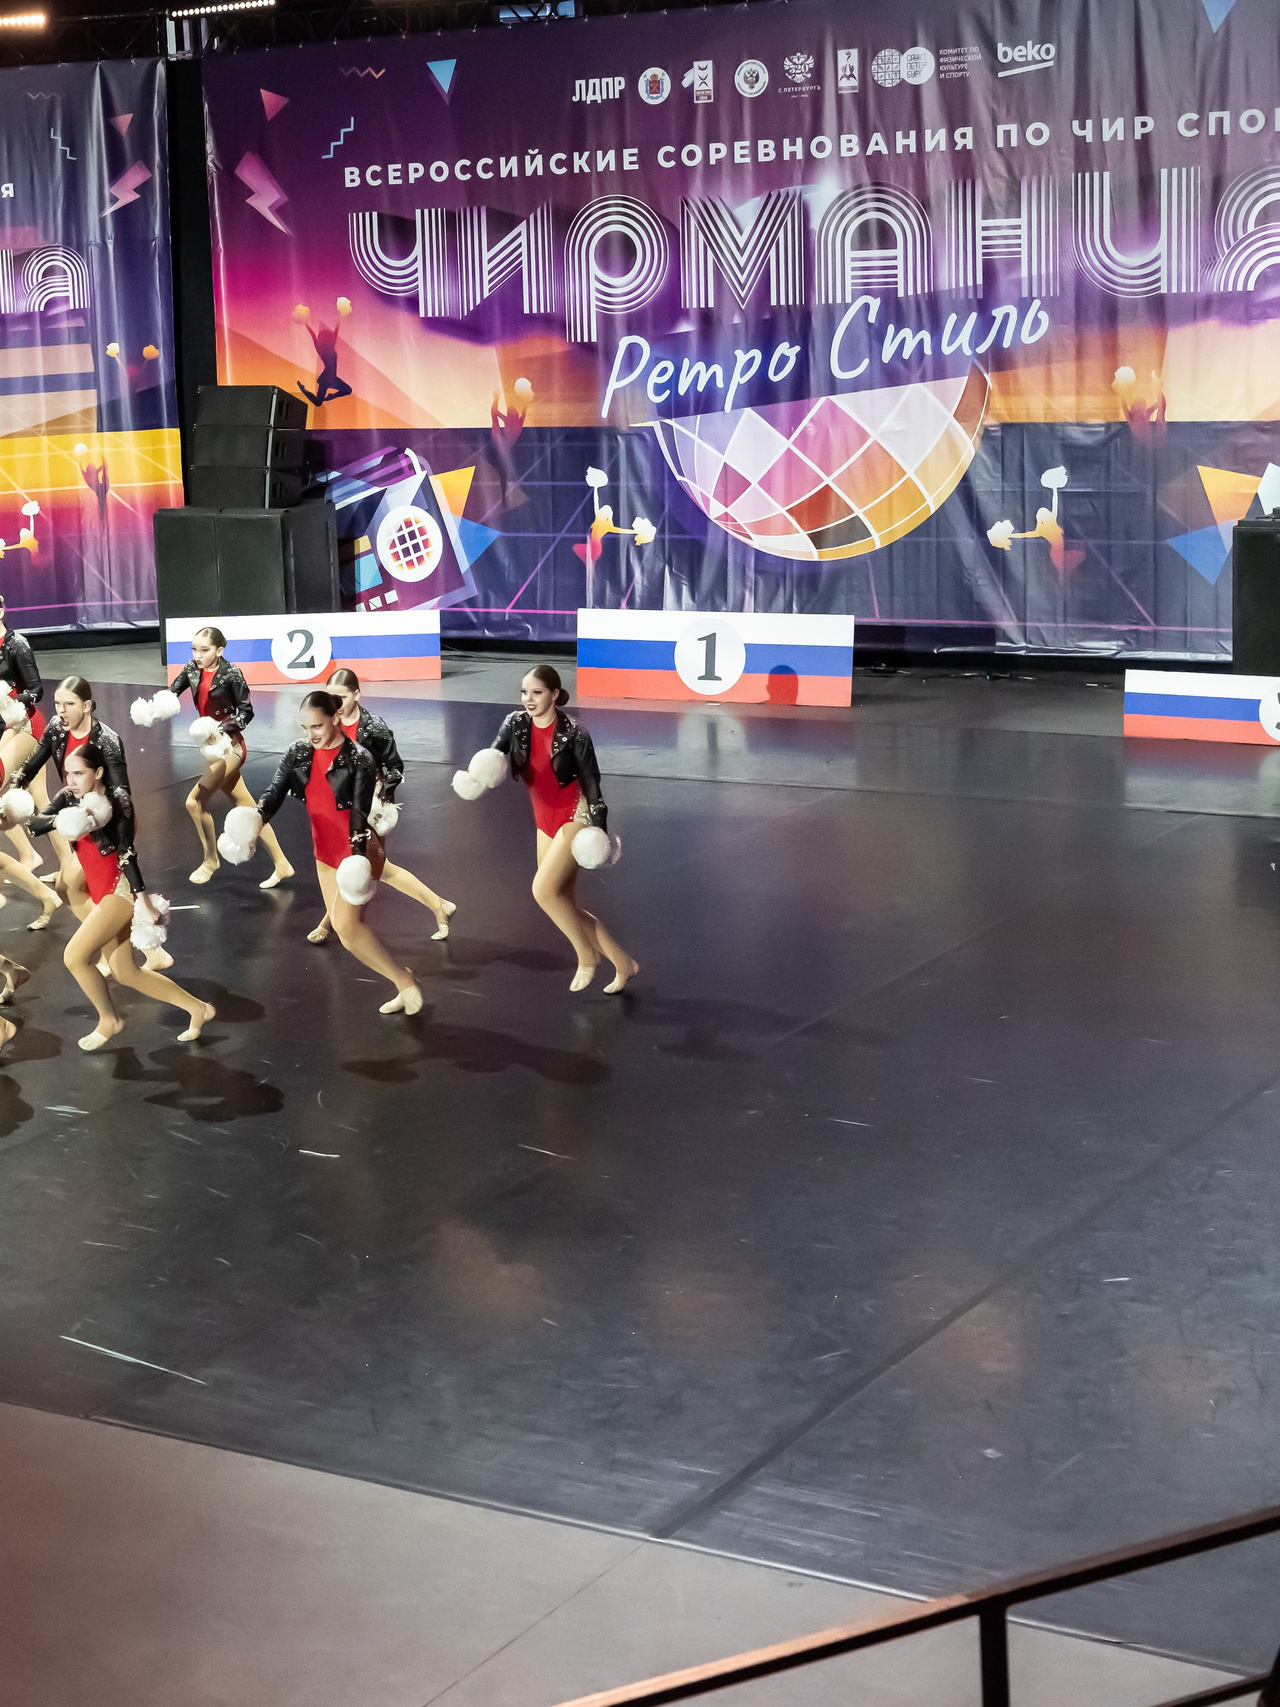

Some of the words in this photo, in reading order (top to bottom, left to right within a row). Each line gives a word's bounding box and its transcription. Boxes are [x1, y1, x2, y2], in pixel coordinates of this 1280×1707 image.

[939, 47, 968, 55] КОМИТЕТ
[997, 40, 1056, 63] beko
[572, 76, 626, 104] ЛДПР
[945, 71, 970, 79] СПОРТУ
[344, 148, 640, 188] ВСЕРОССИЙСКИЕ
[656, 126, 974, 169] СОРЕВНОВАНИЯ
[996, 121, 1051, 149] ПО
[1071, 115, 1155, 143] ЧИР
[601, 334, 801, 418] Ретро
[830, 295, 1050, 379] Стиль
[286, 629, 316, 669] 2
[697, 632, 723, 681] 1
